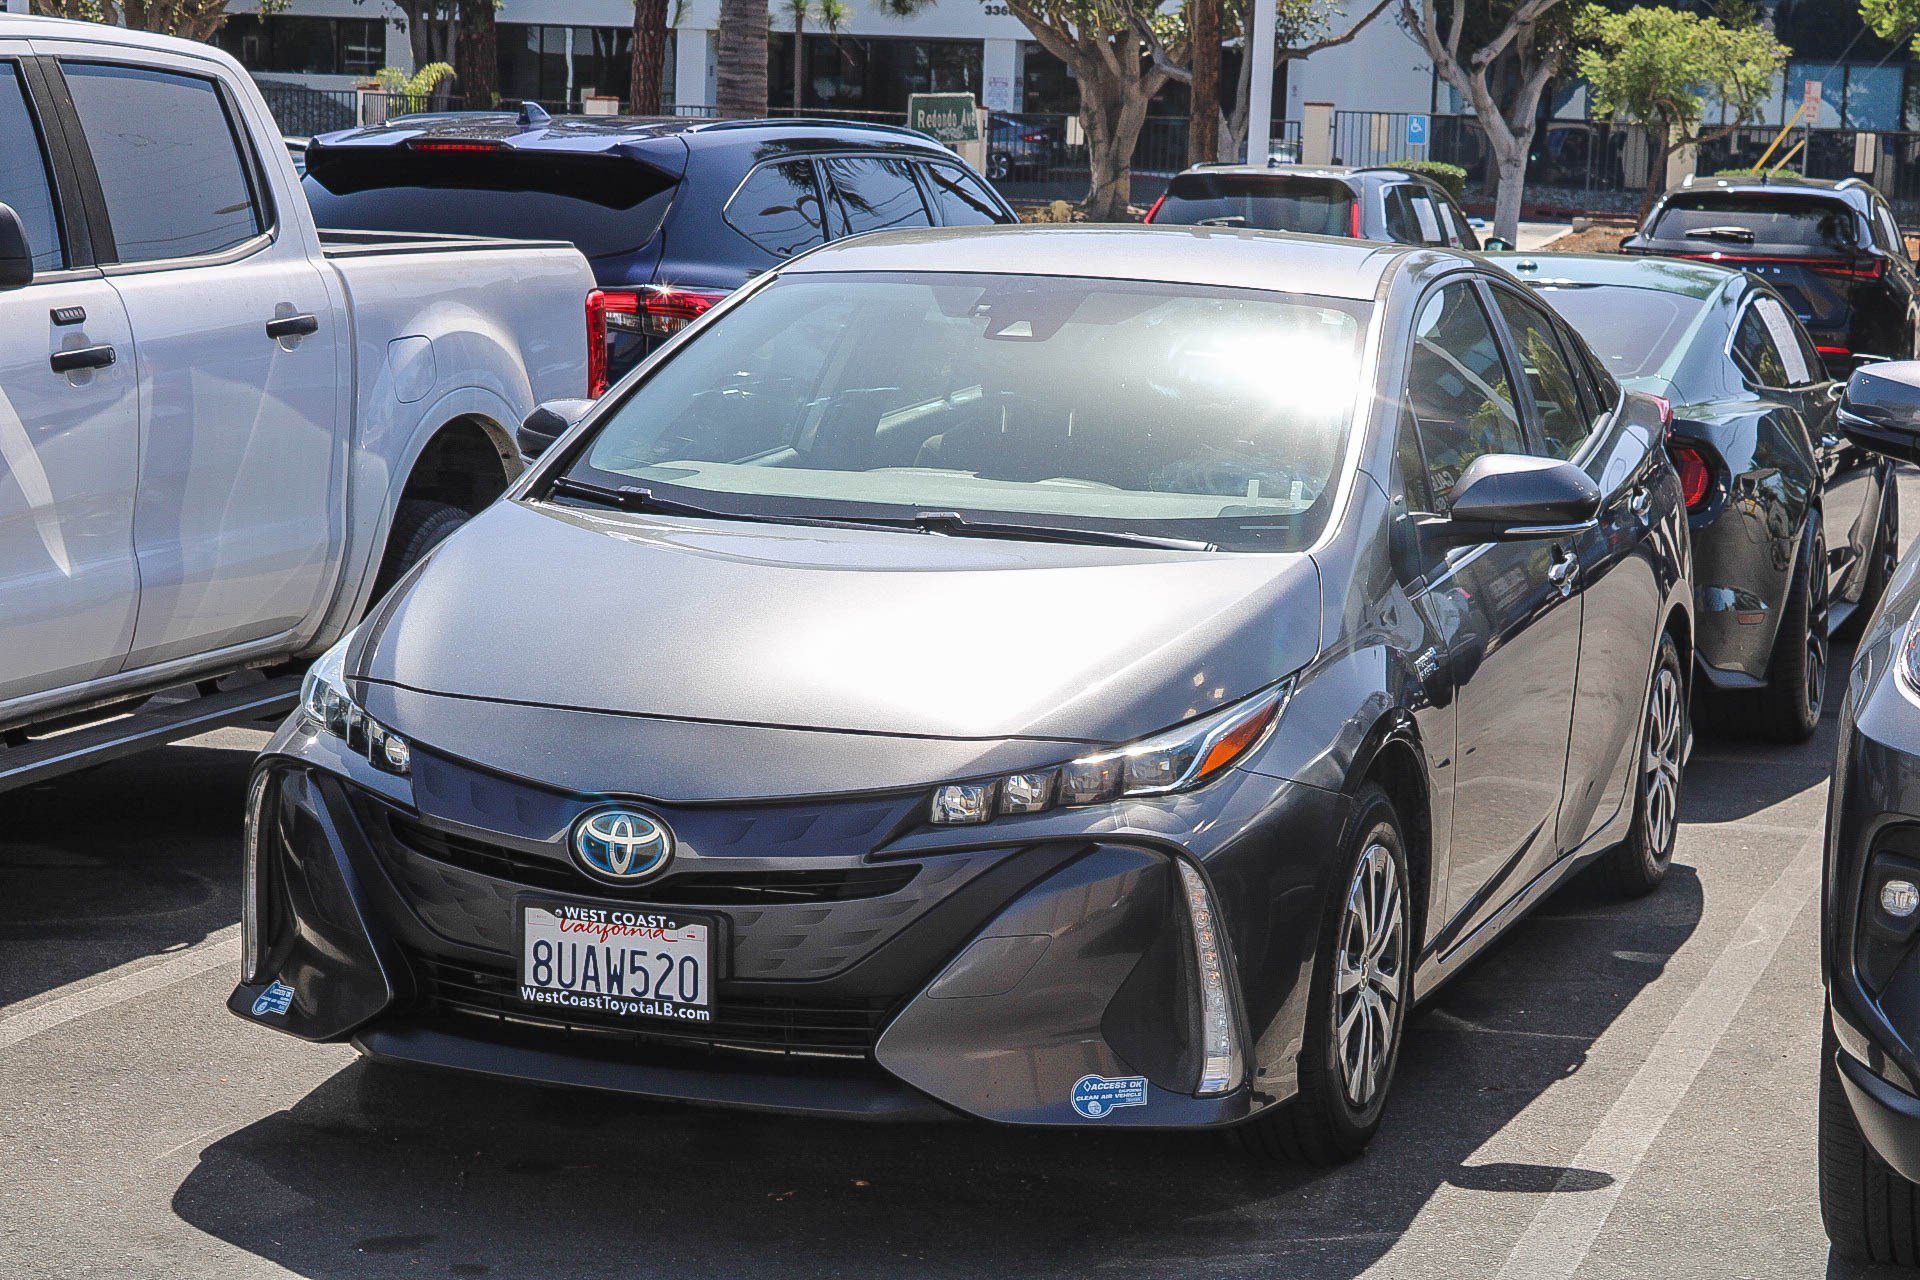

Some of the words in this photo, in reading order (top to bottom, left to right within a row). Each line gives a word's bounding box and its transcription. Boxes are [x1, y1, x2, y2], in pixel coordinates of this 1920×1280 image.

[918, 109, 957, 129] Redondo
[564, 906, 607, 923] WEST
[612, 912, 667, 928] COAST
[560, 916, 678, 944] California
[532, 939, 699, 1003] 8UAW520
[521, 986, 710, 1021] WestCoastToyotaLB.com
[1091, 1082, 1127, 1091] ACCESS
